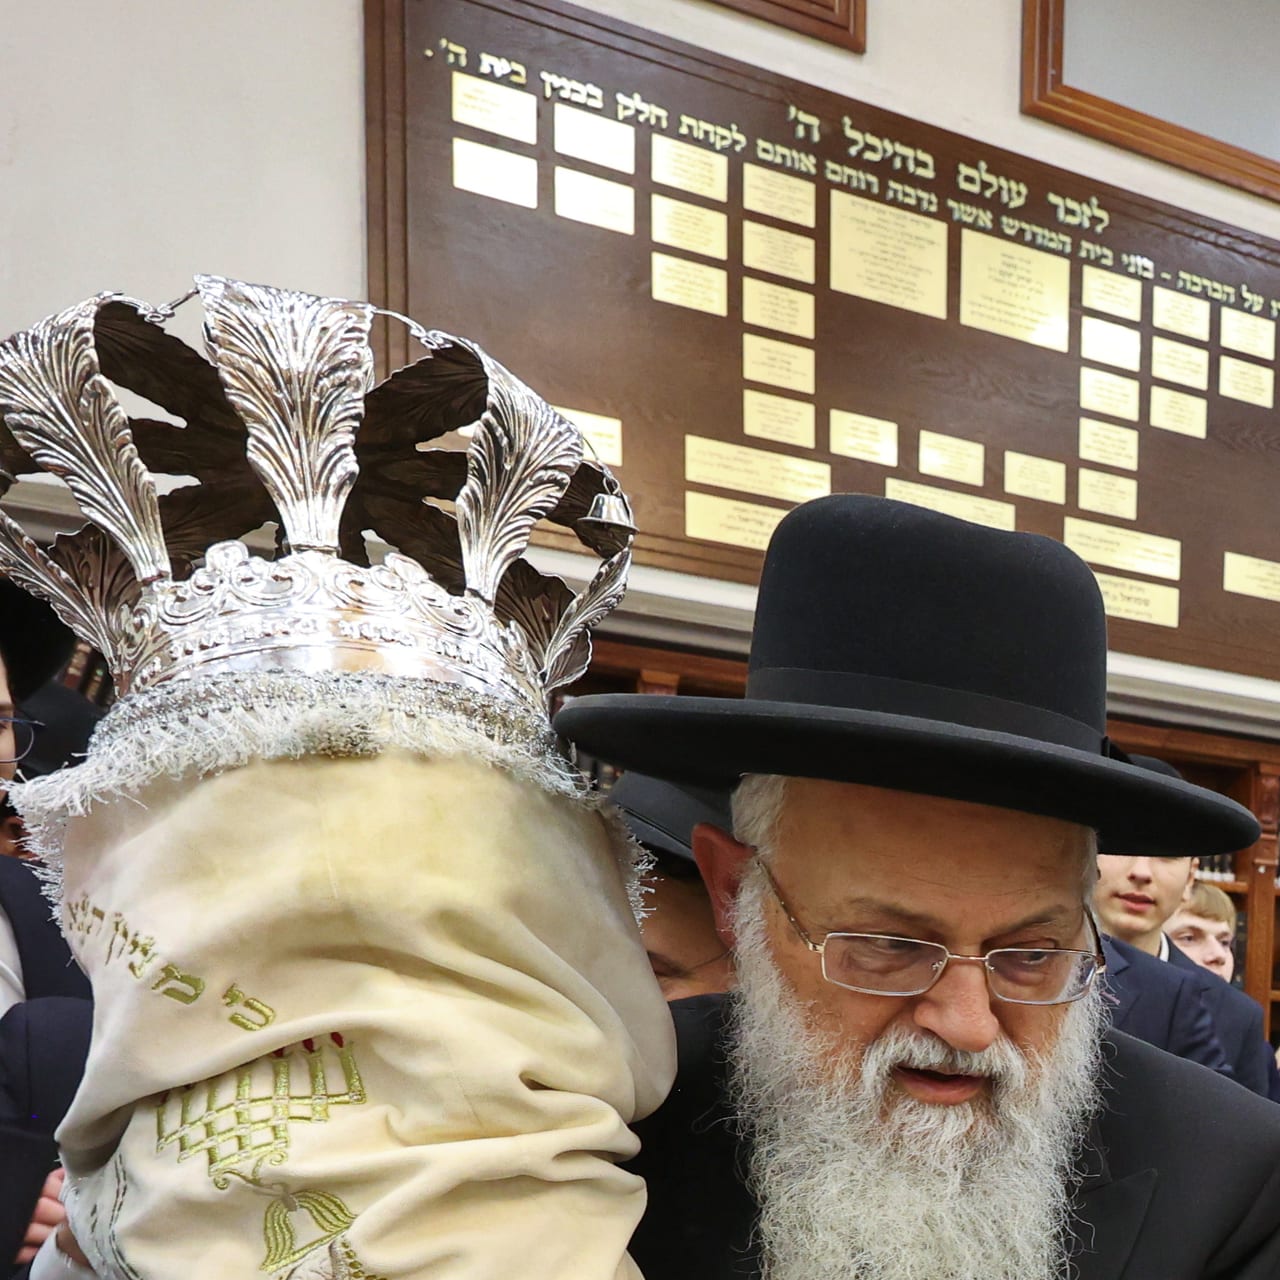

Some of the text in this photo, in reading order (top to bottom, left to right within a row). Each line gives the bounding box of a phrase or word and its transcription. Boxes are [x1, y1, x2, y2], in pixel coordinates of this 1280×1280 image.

[478, 51, 527, 85] בית
[539, 69, 604, 110] בבנין
[616, 92, 668, 129] חלק
[678, 113, 747, 152] לקחת
[755, 138, 817, 175] אותם
[788, 104, 1110, 233] לזכר עולם בהיכל ה'
[886, 178, 938, 213] נדבה
[946, 197, 993, 230] אשר
[1000, 214, 1073, 254] המדרש
[1078, 239, 1114, 267] בית
[1121, 252, 1155, 280] בוני
[1177, 269, 1235, 303] הברכה
[1241, 283, 1264, 313] על
